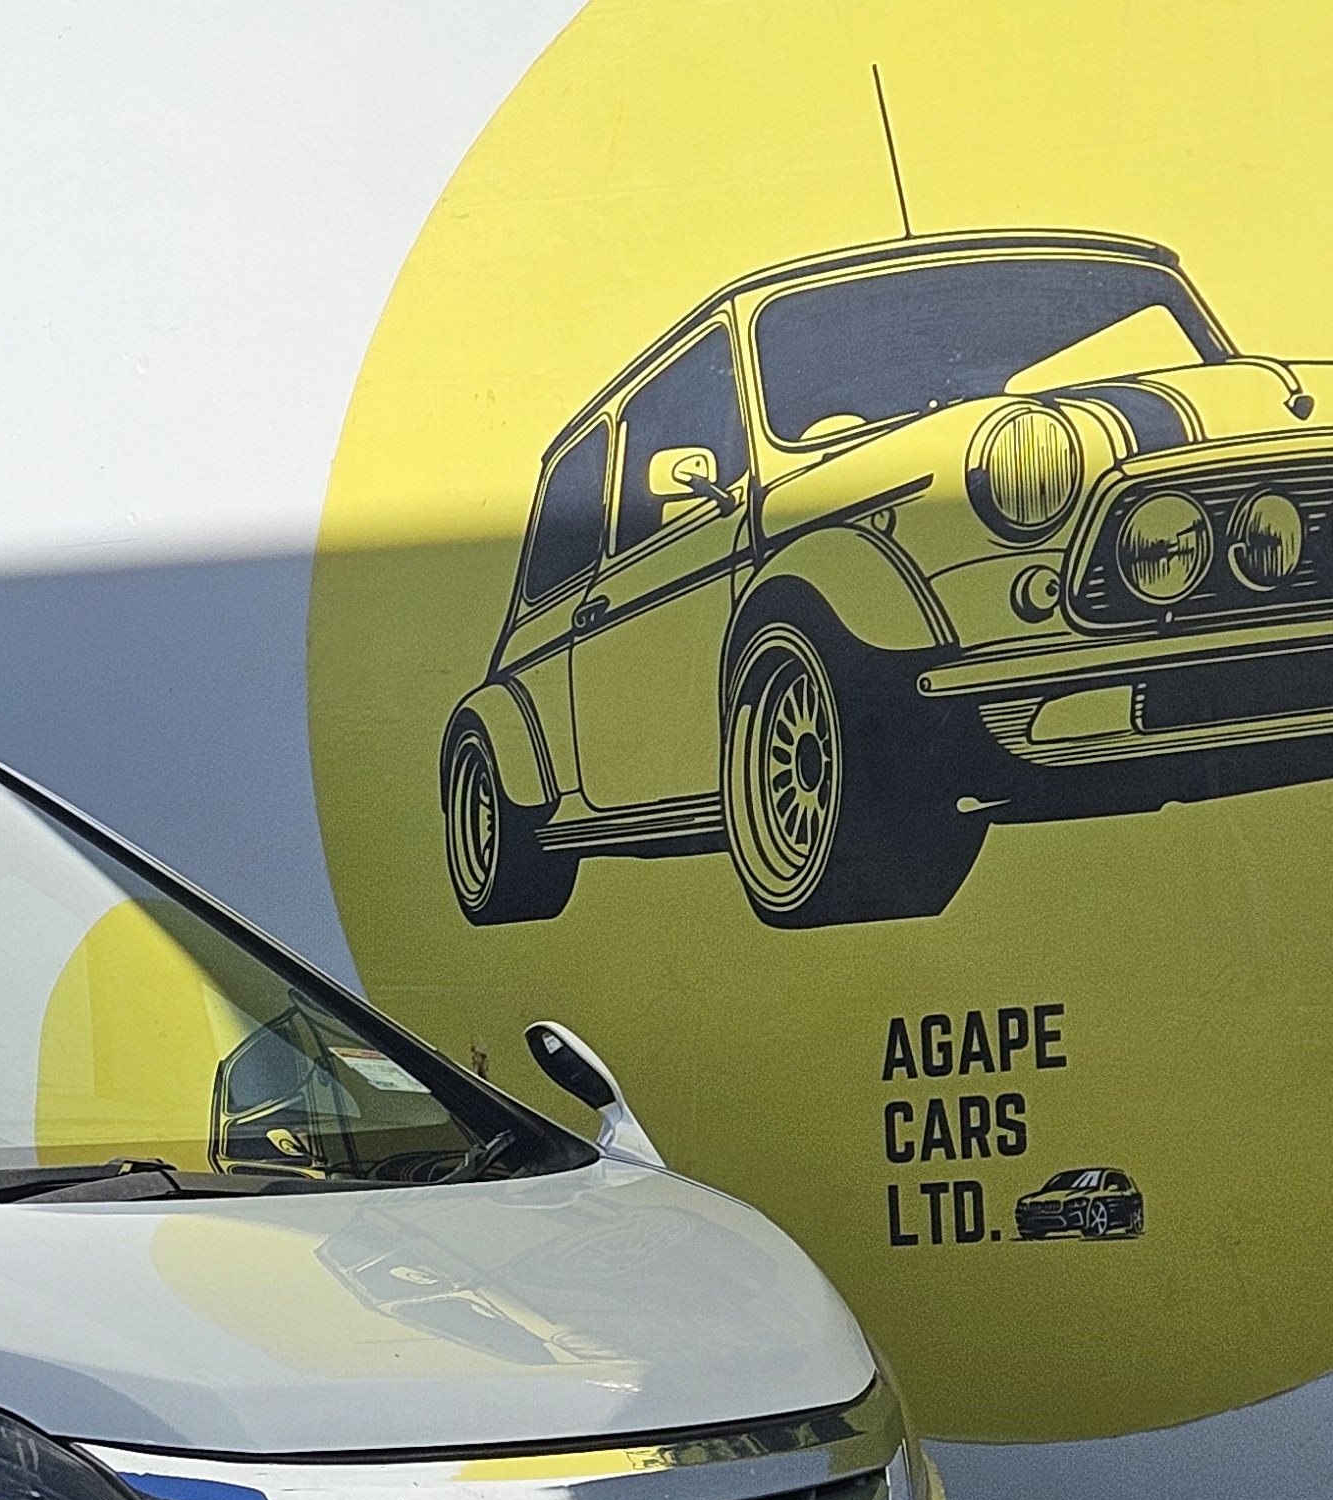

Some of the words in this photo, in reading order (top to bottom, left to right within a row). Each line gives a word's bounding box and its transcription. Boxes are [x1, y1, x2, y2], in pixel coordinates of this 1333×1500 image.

[882, 1003, 1067, 1080] AGAPE
[884, 1093, 1027, 1163] CARS
[888, 1180, 1001, 1247] LTD.
